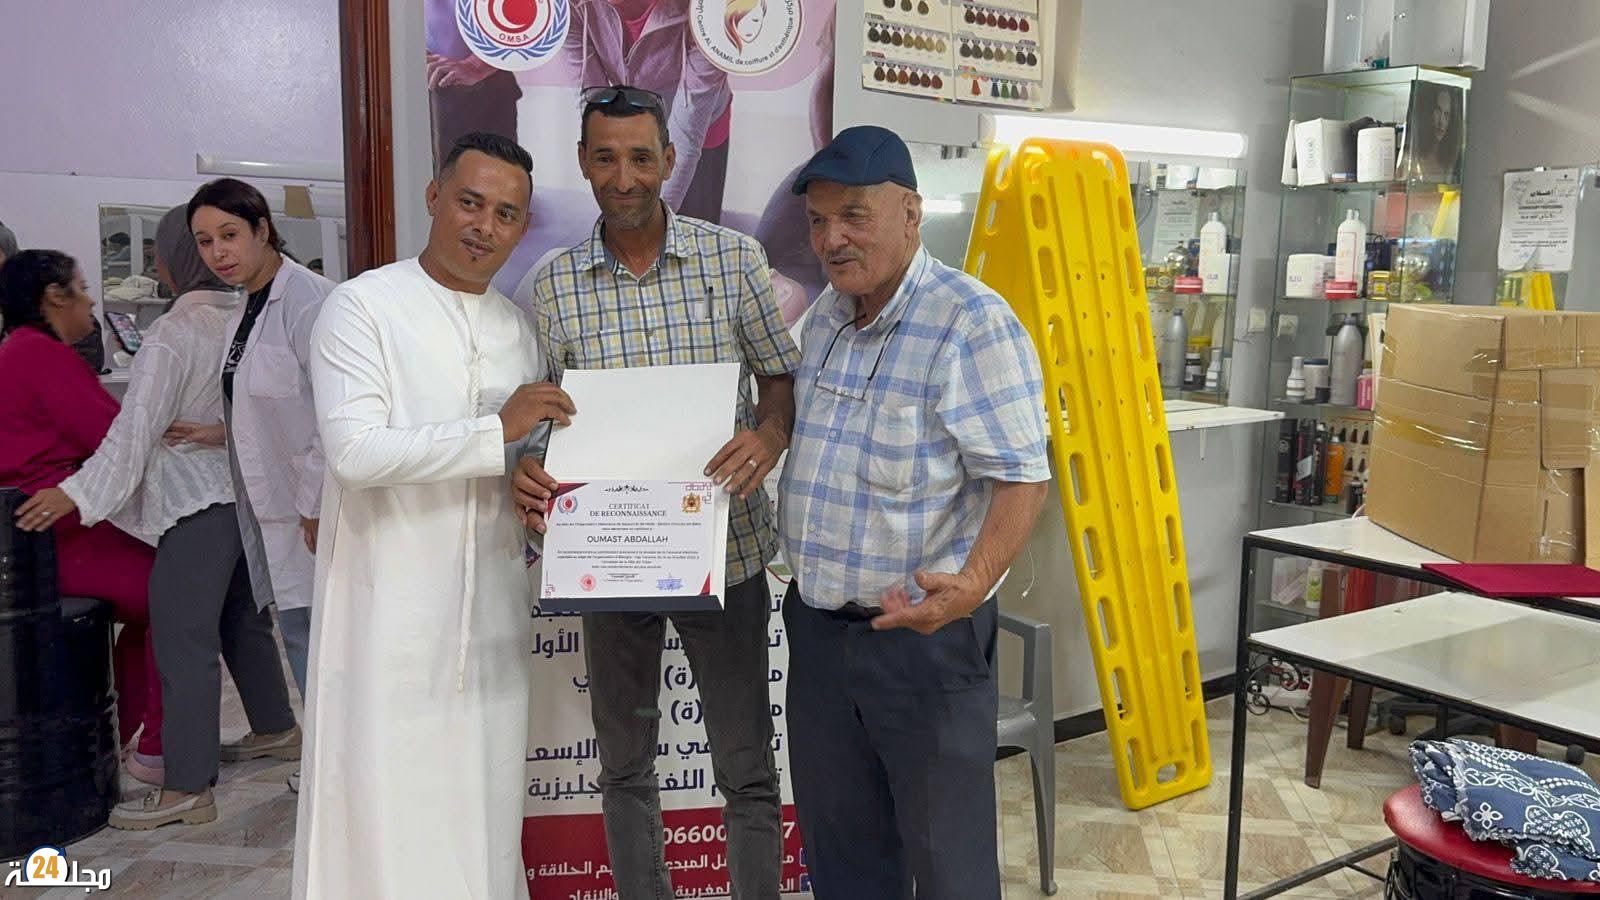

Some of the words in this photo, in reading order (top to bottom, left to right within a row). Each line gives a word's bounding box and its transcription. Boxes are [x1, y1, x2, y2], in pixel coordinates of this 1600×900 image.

[696, 14, 706, 37] Centre
[704, 36, 713, 46] AL
[711, 45, 735, 64] ANAMIL
[744, 55, 769, 66] coiffure
[587, 535, 623, 543] OUMAST
[624, 535, 669, 543] ABDALLAH
[526, 738, 597, 766] الإسع
[528, 774, 602, 801] جليزية
[655, 767, 704, 792] اللغ
[538, 860, 592, 877] الحلاقة
[675, 880, 731, 898] لمغربية
